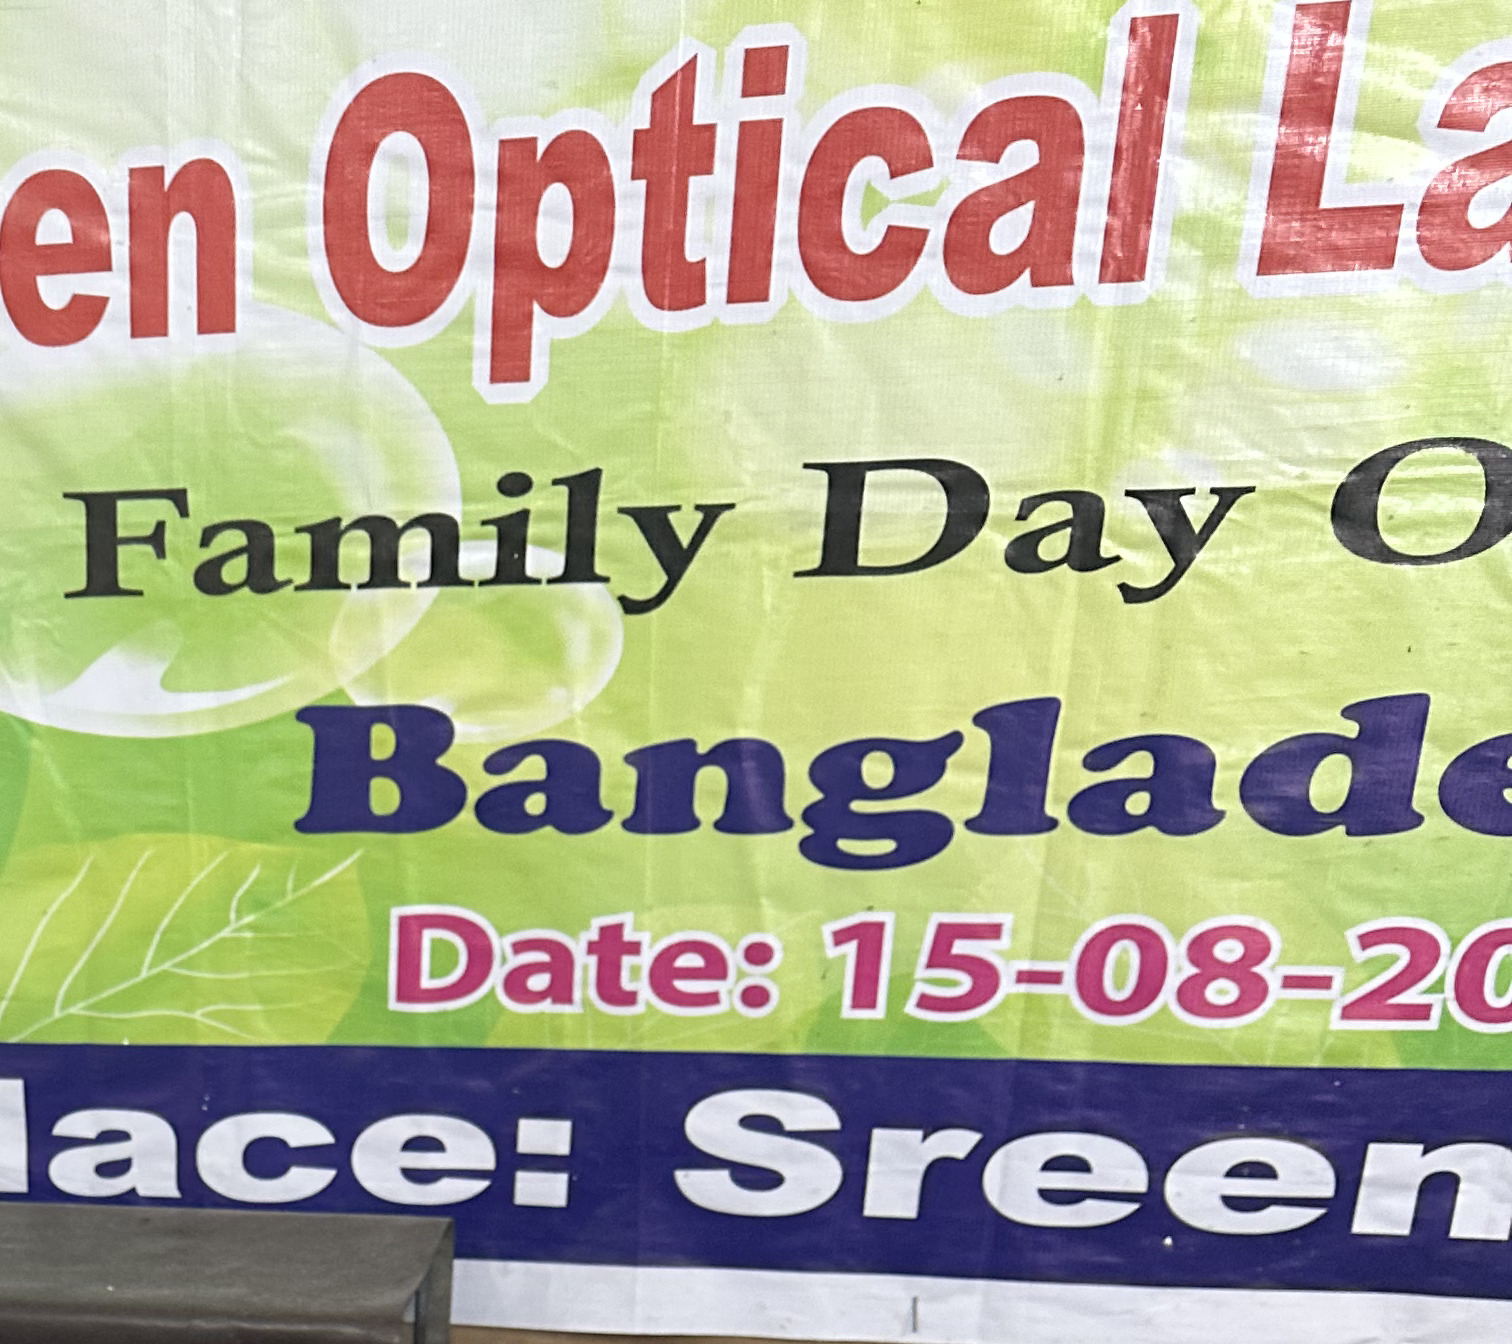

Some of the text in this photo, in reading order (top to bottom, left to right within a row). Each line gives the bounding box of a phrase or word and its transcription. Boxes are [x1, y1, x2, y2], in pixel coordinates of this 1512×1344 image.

[321, 12, 1180, 385] Optical
[62, 436, 1512, 616] Family Day O
[391, 910, 782, 1010] Date:
